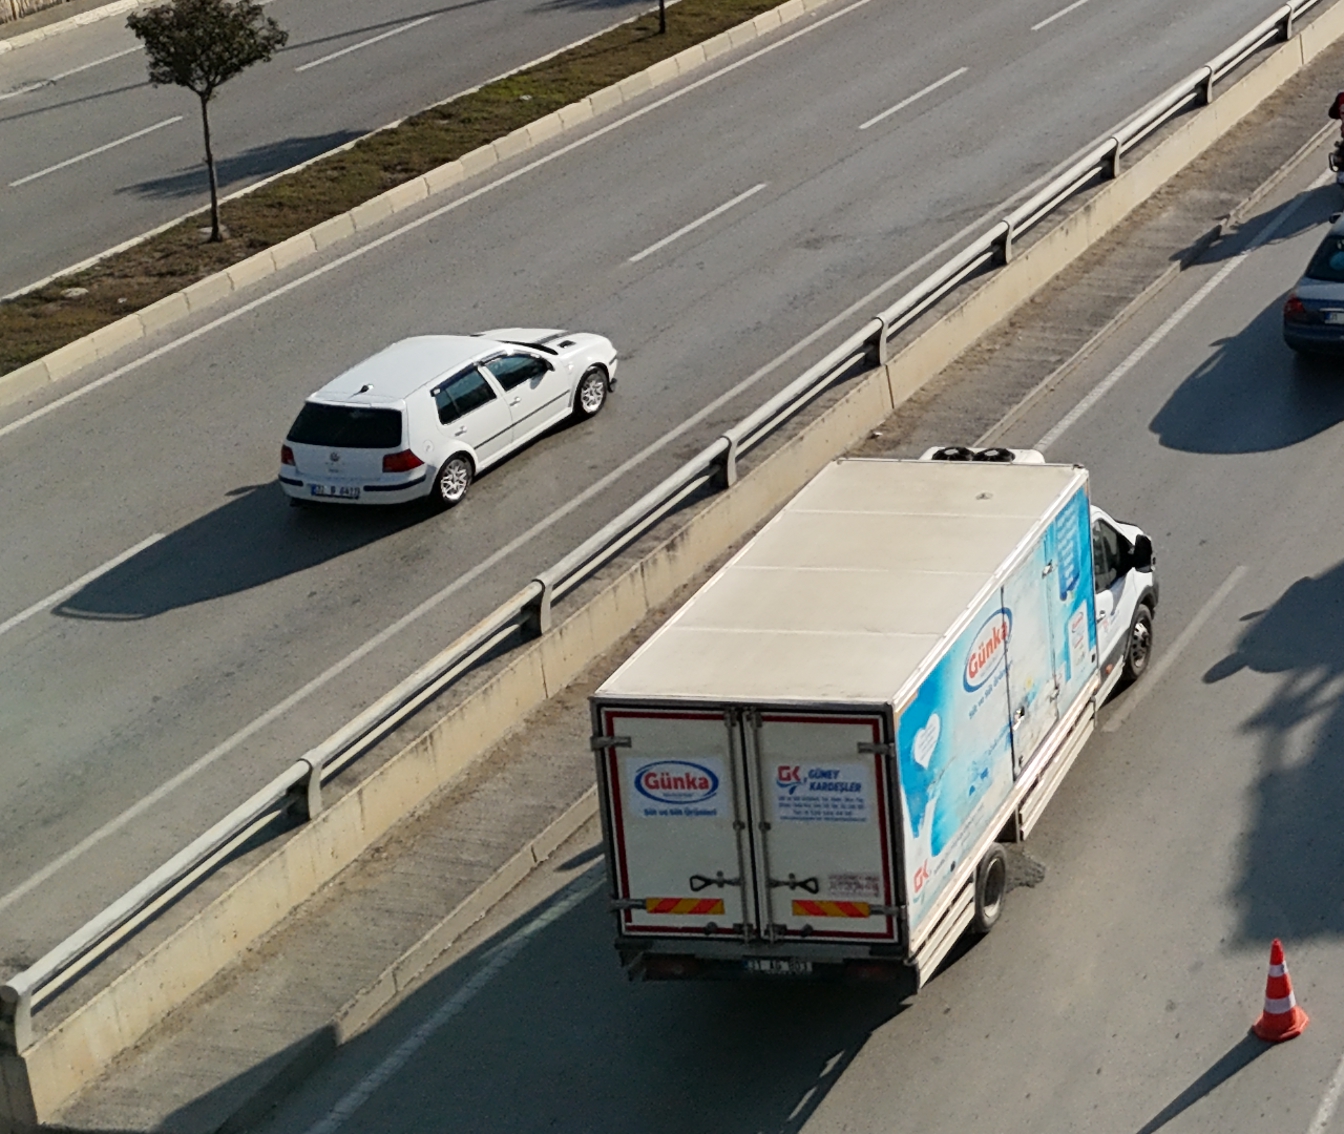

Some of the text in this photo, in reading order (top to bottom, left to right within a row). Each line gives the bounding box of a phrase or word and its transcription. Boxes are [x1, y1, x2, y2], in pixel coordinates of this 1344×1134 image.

[967, 620, 1009, 679] Günka
[644, 771, 710, 791] Günka
[808, 767, 840, 780] GÜNEY
[809, 781, 862, 793] KARDEŞLER
